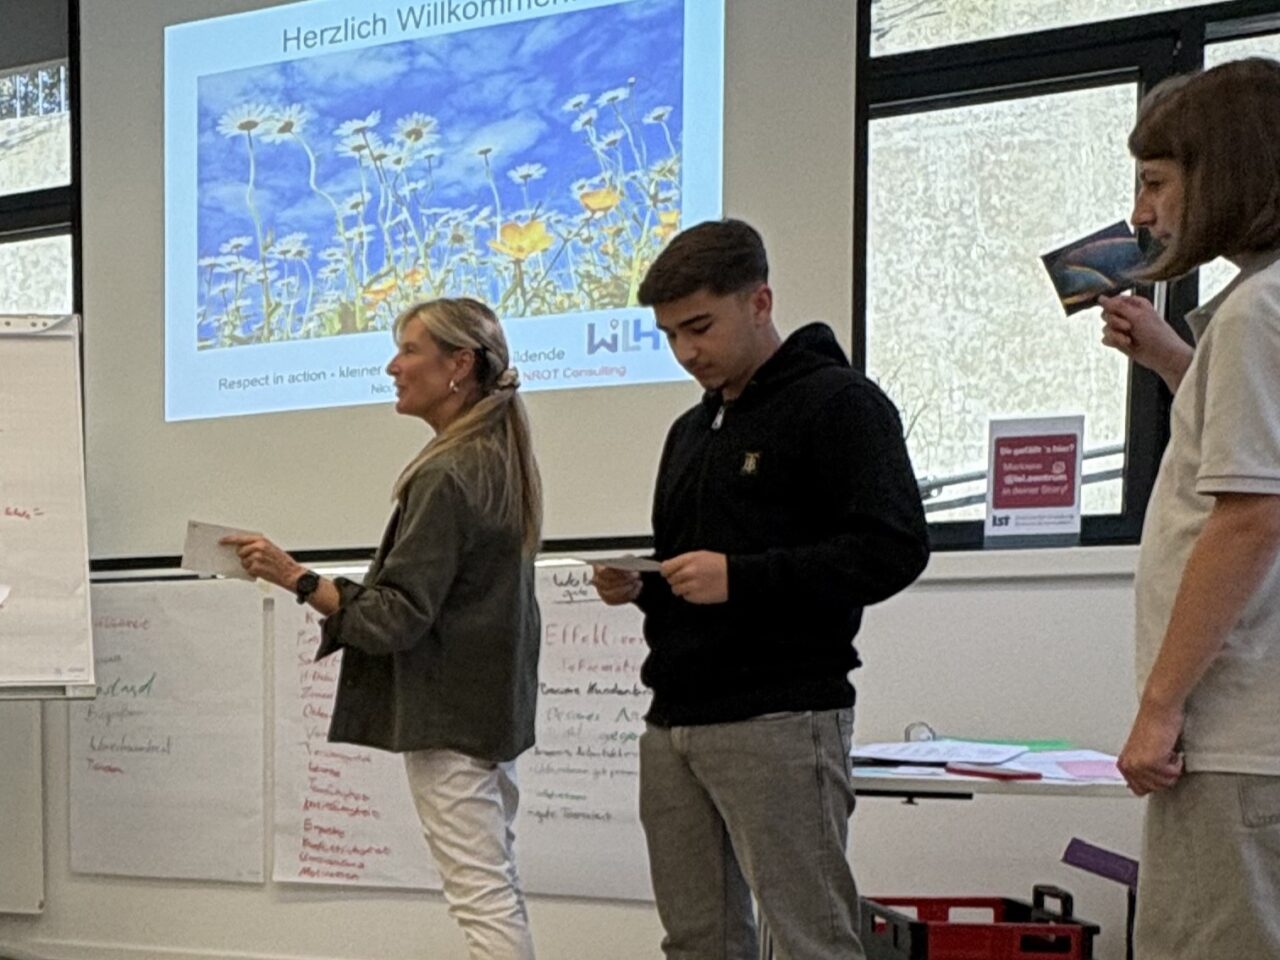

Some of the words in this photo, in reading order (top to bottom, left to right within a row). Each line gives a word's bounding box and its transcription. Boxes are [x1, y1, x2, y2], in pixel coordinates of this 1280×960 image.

[283, 16, 387, 52] Herzlich
[397, 0, 577, 32] Willkomm
[219, 373, 271, 391] Respect
[273, 373, 285, 386] in
[287, 369, 327, 384] action
[338, 363, 382, 380] kleiner
[562, 365, 627, 378] Consulting
